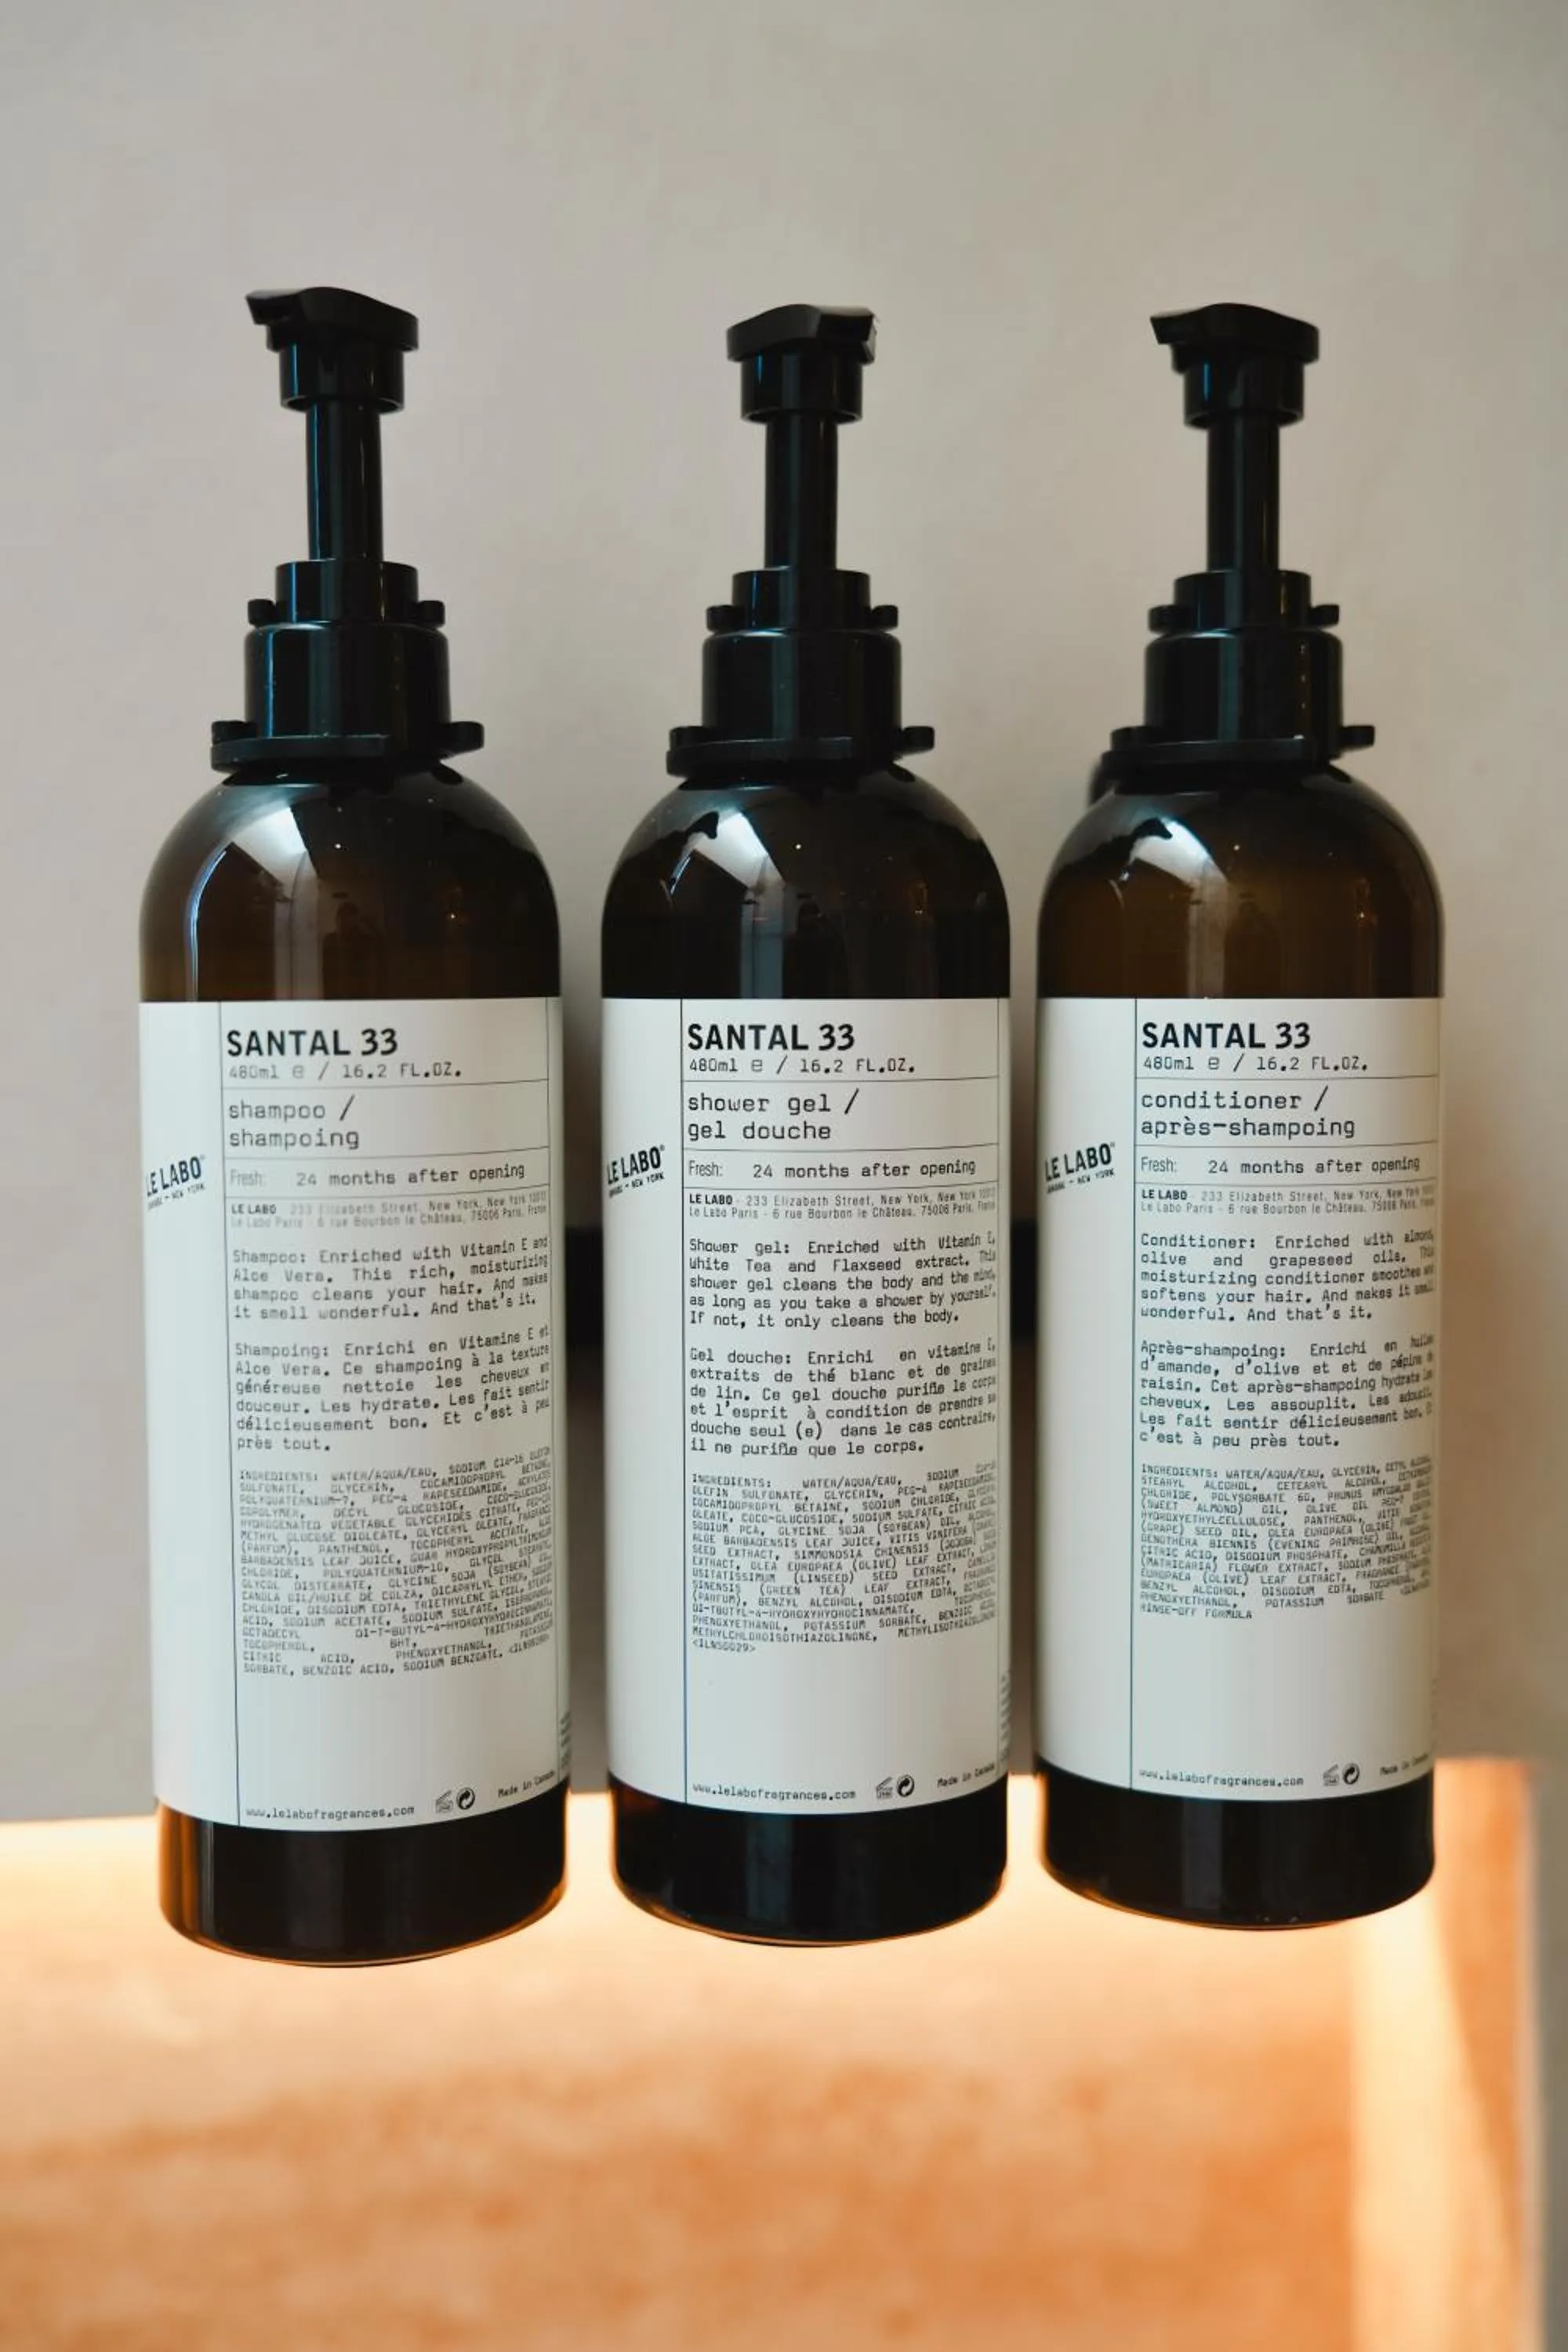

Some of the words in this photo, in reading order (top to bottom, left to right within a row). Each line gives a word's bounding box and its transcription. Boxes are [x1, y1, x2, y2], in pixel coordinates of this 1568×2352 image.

[227, 1029, 351, 1057] SANTAL
[361, 1029, 397, 1056] 33
[688, 1024, 809, 1051] SANTAL
[818, 1024, 855, 1051] 33
[1142, 1022, 1265, 1048] SANTAL
[1276, 1022, 1310, 1049] 33
[230, 1064, 279, 1079] 480ml
[343, 1064, 387, 1079] 16.2
[401, 1062, 461, 1078] FL.OZ.
[690, 1058, 738, 1073] 480ml
[800, 1058, 843, 1074] 16.2
[857, 1058, 914, 1073] FL.OZ.
[1143, 1056, 1194, 1070] 480ml
[1257, 1057, 1299, 1072] 16.2
[1312, 1056, 1367, 1071] FL.OZ.
[688, 1093, 769, 1112] shower
[788, 1094, 831, 1116] gel
[1142, 1091, 1301, 1109] conditioner
[229, 1100, 325, 1123] shampoo
[230, 1128, 359, 1150] shampoing
[688, 1120, 726, 1142] gel
[743, 1121, 830, 1139] douche
[1142, 1116, 1355, 1140] après-shampoing
[160, 1156, 202, 1189] LABO
[621, 1146, 661, 1178] LABO
[688, 1160, 722, 1177] Fresh:
[753, 1164, 772, 1178] 24
[785, 1163, 849, 1178] months
[862, 1163, 910, 1177] after
[920, 1160, 975, 1178] opening
[1045, 1157, 1060, 1181] LE
[1064, 1143, 1112, 1174] LABO
[1142, 1156, 1176, 1172] Fresh:
[1208, 1160, 1228, 1174] 24
[1241, 1160, 1304, 1174] months
[1316, 1159, 1362, 1173] after
[1371, 1156, 1419, 1174] opening
[296, 1172, 317, 1186] 24
[329, 1171, 396, 1185] months
[408, 1169, 459, 1183] after
[470, 1163, 524, 1182] opening
[690, 1193, 702, 1204] LE
[706, 1195, 732, 1205] LABO
[1142, 1189, 1155, 1199] LE
[1158, 1190, 1188, 1200] LABO
[231, 1204, 244, 1214] LE
[248, 1204, 276, 1214] LABO
[690, 1239, 739, 1253] Shower
[755, 1241, 789, 1256] gel:
[808, 1240, 879, 1254] Enriched
[893, 1237, 925, 1252] with
[1142, 1233, 1254, 1249] Conditioner:
[1276, 1235, 1349, 1249] Enriched
[1364, 1232, 1393, 1246] with
[233, 1249, 306, 1266] Shampoo:
[320, 1249, 401, 1263] Enriched
[413, 1246, 451, 1260] with
[461, 1240, 515, 1258] Vitamin
[234, 1287, 299, 1303] shampoo
[313, 1287, 373, 1301] cleans
[388, 1287, 426, 1301] your
[440, 1280, 482, 1295] hair.
[493, 1276, 514, 1291] And
[1142, 1287, 1206, 1301] softens
[1217, 1293, 1255, 1305] your
[1265, 1290, 1311, 1304] hair.
[1322, 1289, 1348, 1301] And
[1356, 1287, 1392, 1300] makes
[1399, 1284, 1410, 1298] it
[234, 1305, 251, 1318] it
[260, 1306, 308, 1319] smell
[319, 1303, 419, 1319] wonderful.
[430, 1301, 458, 1314] And
[467, 1291, 513, 1312] that's
[519, 1292, 535, 1305] it.
[690, 1296, 705, 1306] as
[712, 1294, 745, 1311] long
[753, 1299, 771, 1308] as
[780, 1299, 807, 1312] you
[815, 1295, 851, 1309] take
[858, 1298, 867, 1308] a
[876, 1294, 924, 1308] shower
[930, 1292, 945, 1307] by
[1142, 1306, 1235, 1322] wonderful.
[1247, 1308, 1276, 1321] And
[1287, 1303, 1341, 1320] that's
[1349, 1305, 1372, 1319] it.
[690, 1310, 705, 1323] If
[713, 1313, 746, 1330] not,
[757, 1314, 775, 1327] it
[786, 1314, 820, 1330] only
[831, 1313, 884, 1327] cleans
[894, 1311, 916, 1325] the
[924, 1308, 958, 1324] body.
[235, 1342, 328, 1359] Shampoing:
[345, 1340, 415, 1356] Enrichi
[429, 1341, 447, 1352] en
[459, 1332, 521, 1349] Vitamine
[690, 1348, 714, 1362] Gel
[728, 1350, 790, 1364] douche:
[808, 1349, 873, 1365] Enrichi
[899, 1350, 916, 1362] en
[928, 1343, 981, 1359] vitamine
[1142, 1340, 1285, 1361] Après-shampoing:
[1311, 1341, 1367, 1356] Enrichi
[1385, 1341, 1397, 1352] en
[238, 1436, 272, 1450] près
[283, 1436, 330, 1451] tout.
[1140, 1425, 1183, 1444] c'est
[1193, 1432, 1202, 1446] à
[1213, 1436, 1240, 1448] peu
[1250, 1433, 1287, 1449] près
[1298, 1433, 1339, 1446] tout.
[691, 1439, 706, 1451] il
[715, 1443, 731, 1454] ne
[808, 1445, 836, 1458] que
[847, 1442, 864, 1454] le
[874, 1440, 924, 1454] corps.
